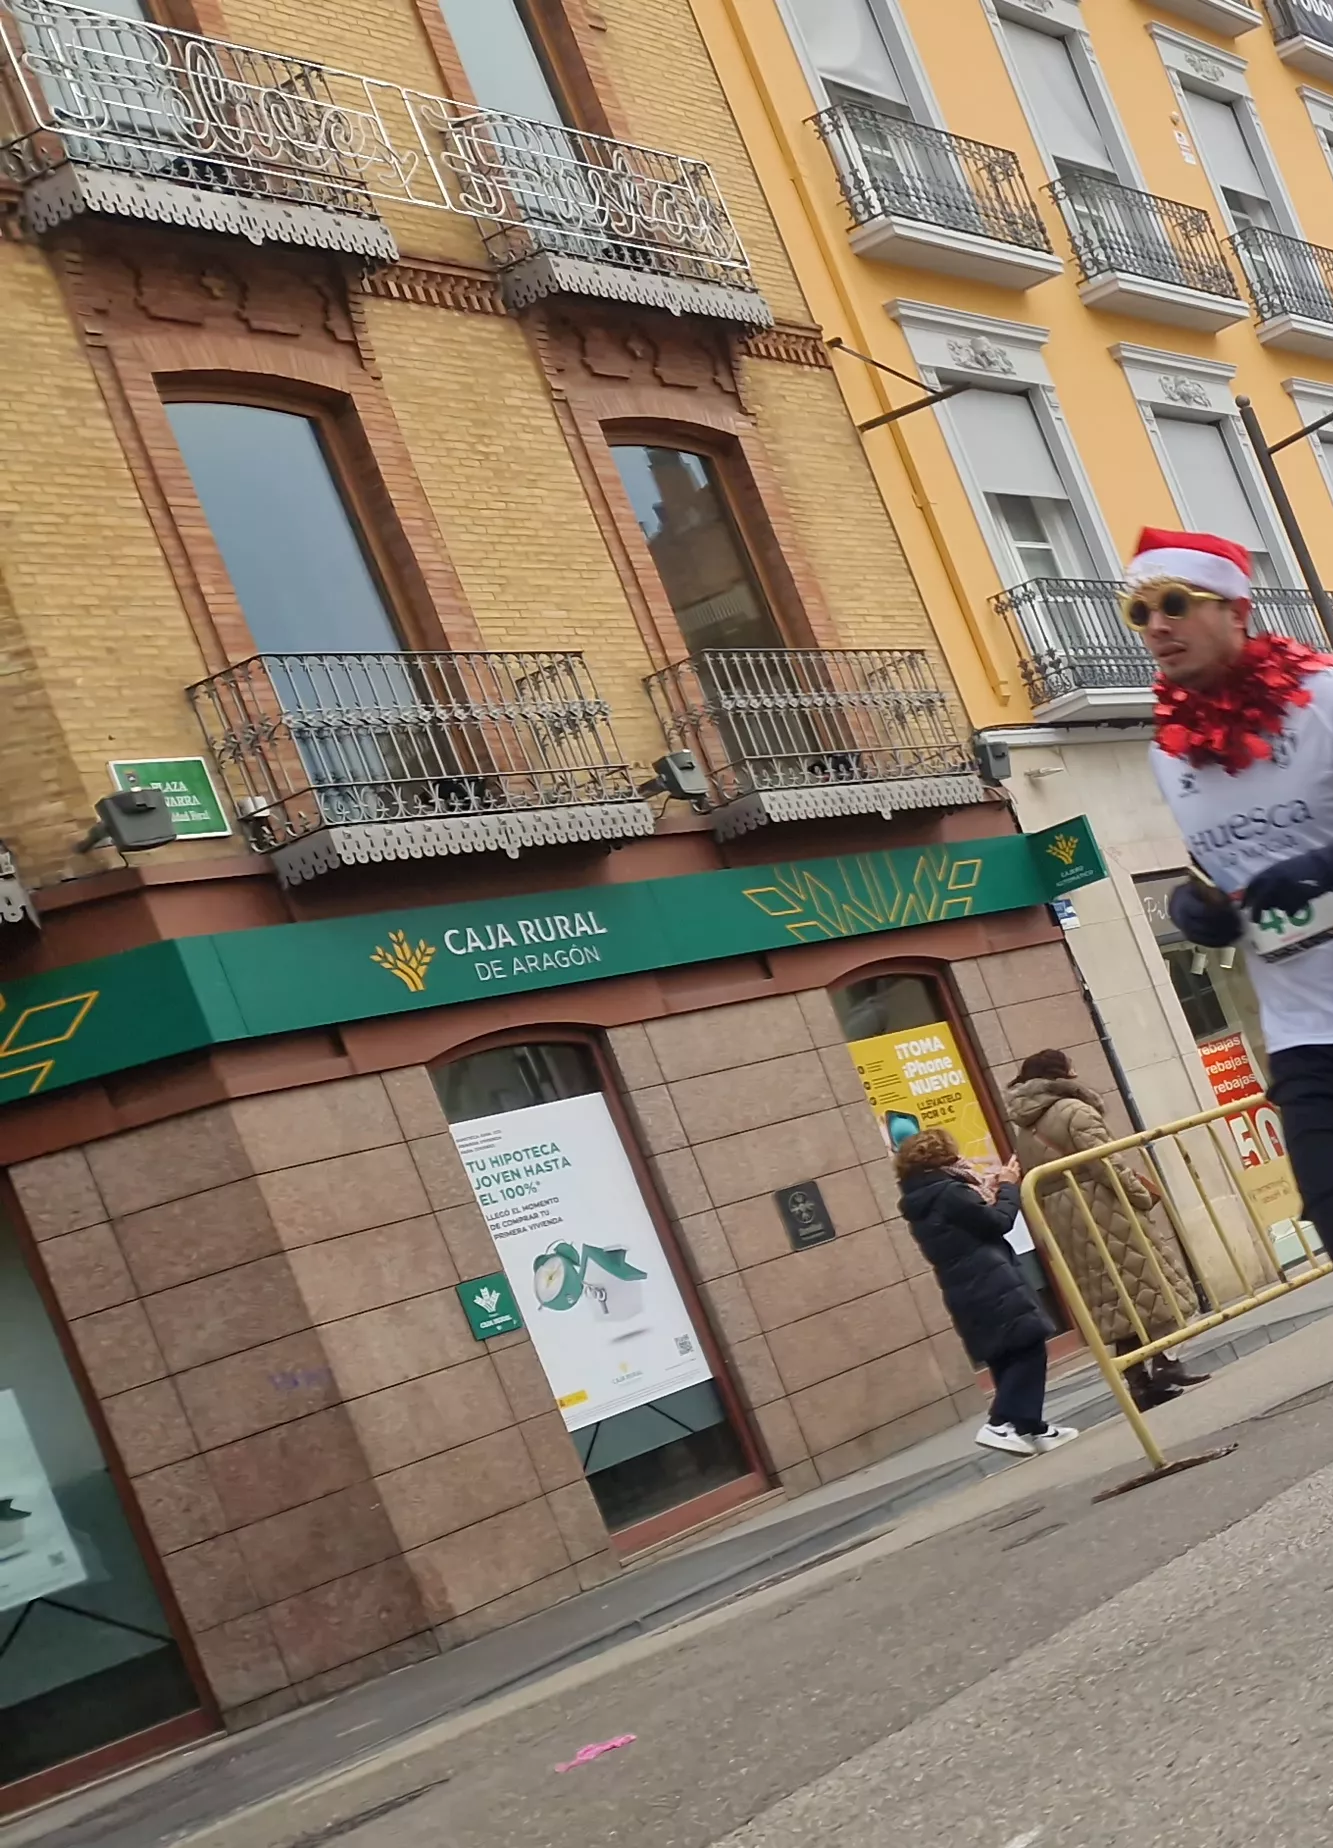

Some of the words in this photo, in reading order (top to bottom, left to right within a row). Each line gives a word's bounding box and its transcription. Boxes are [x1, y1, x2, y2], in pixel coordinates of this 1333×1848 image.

[421, 104, 737, 260] Fiestas
[164, 795, 202, 807] VARRA
[1144, 893, 1171, 922] Pil
[443, 923, 518, 955] CAJA
[517, 911, 608, 944] RURAL
[474, 960, 507, 981] DE
[513, 944, 602, 976] ARAGÓN
[1199, 1035, 1241, 1057] rebajas
[1205, 1054, 1249, 1076] rebajas
[908, 1069, 966, 1096] NUEVO!
[1213, 1073, 1257, 1095] rebajas
[466, 1158, 486, 1173] TU
[488, 1142, 561, 1169] HIPOTECA
[474, 1168, 522, 1190] JOVEN
[523, 1156, 572, 1177] HASTA
[479, 1192, 498, 1206] EL
[512, 1206, 522, 1215] EL
[522, 1197, 560, 1212] MOMENTO
[490, 1222, 501, 1231] DE
[502, 1213, 539, 1228] COMPRAR
[494, 1227, 528, 1240] PRIMERA
[528, 1216, 563, 1231] VIVIENDA
